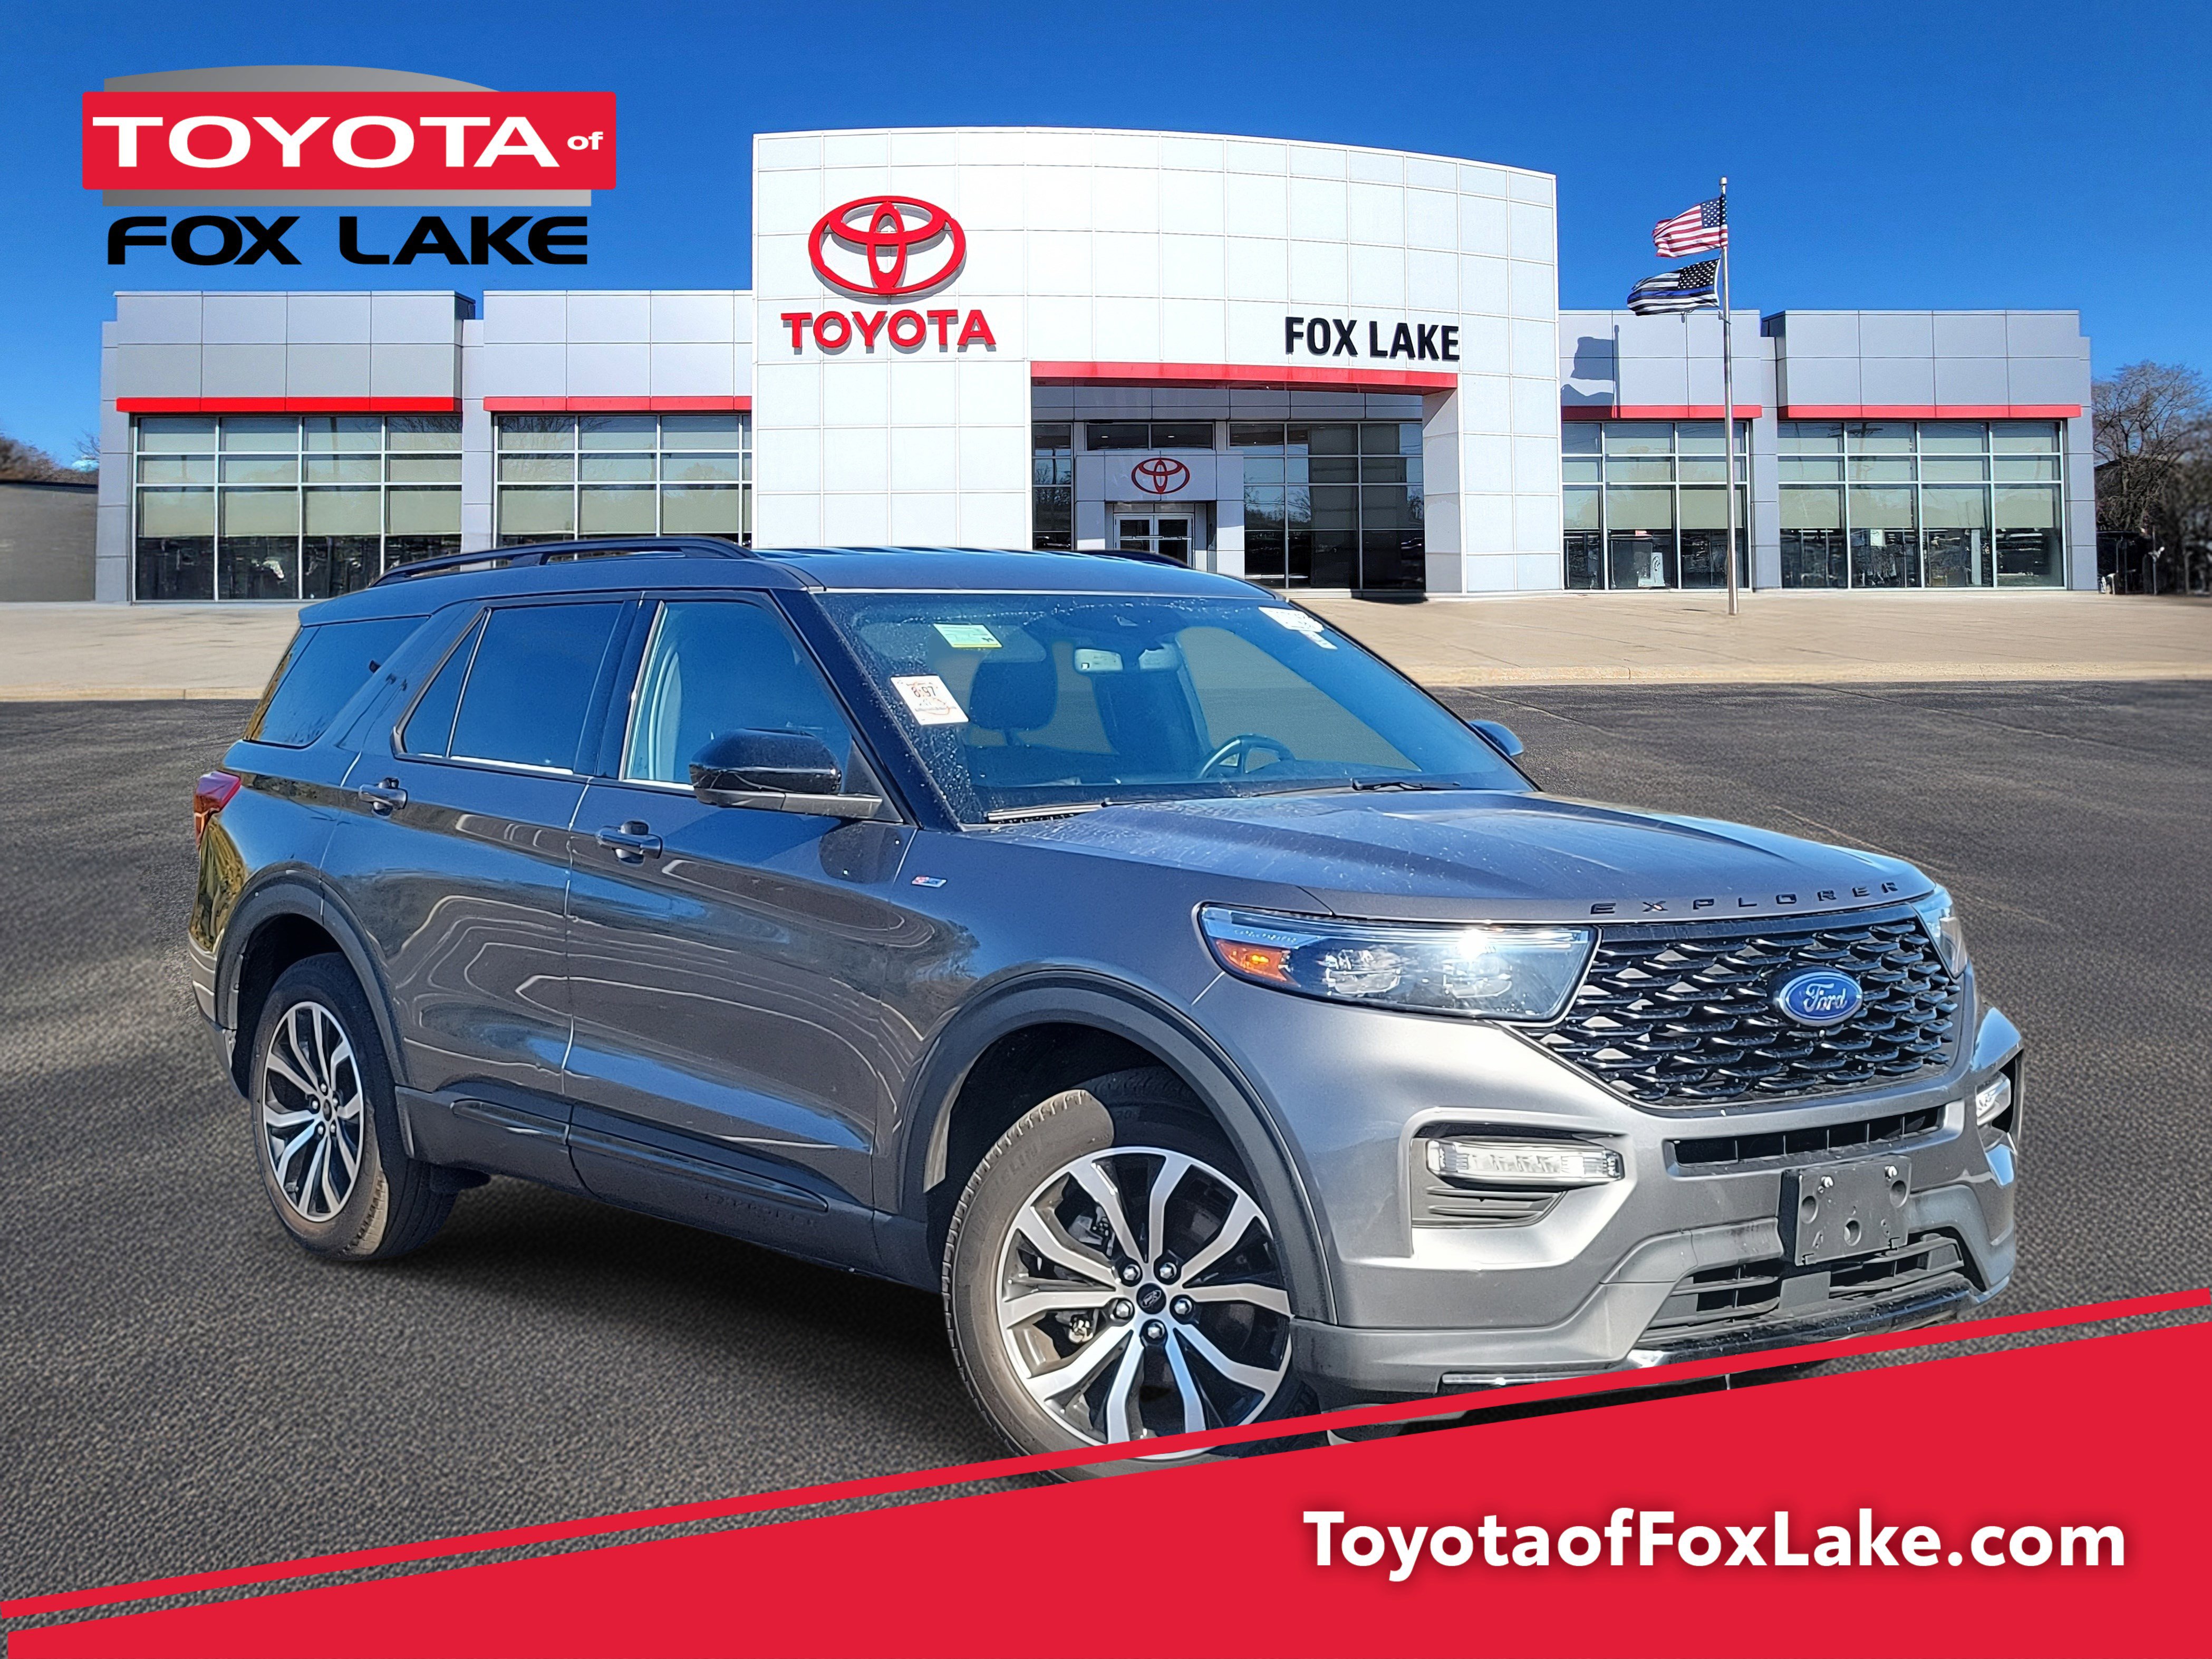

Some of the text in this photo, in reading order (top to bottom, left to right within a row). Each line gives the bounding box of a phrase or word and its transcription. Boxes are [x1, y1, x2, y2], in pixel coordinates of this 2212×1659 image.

[780, 309, 997, 353] TOYOTA
[1285, 316, 1460, 361] FOX LAKE
[1590, 882, 1899, 915] EXPLORER
[1803, 983, 1848, 1012] Ford
